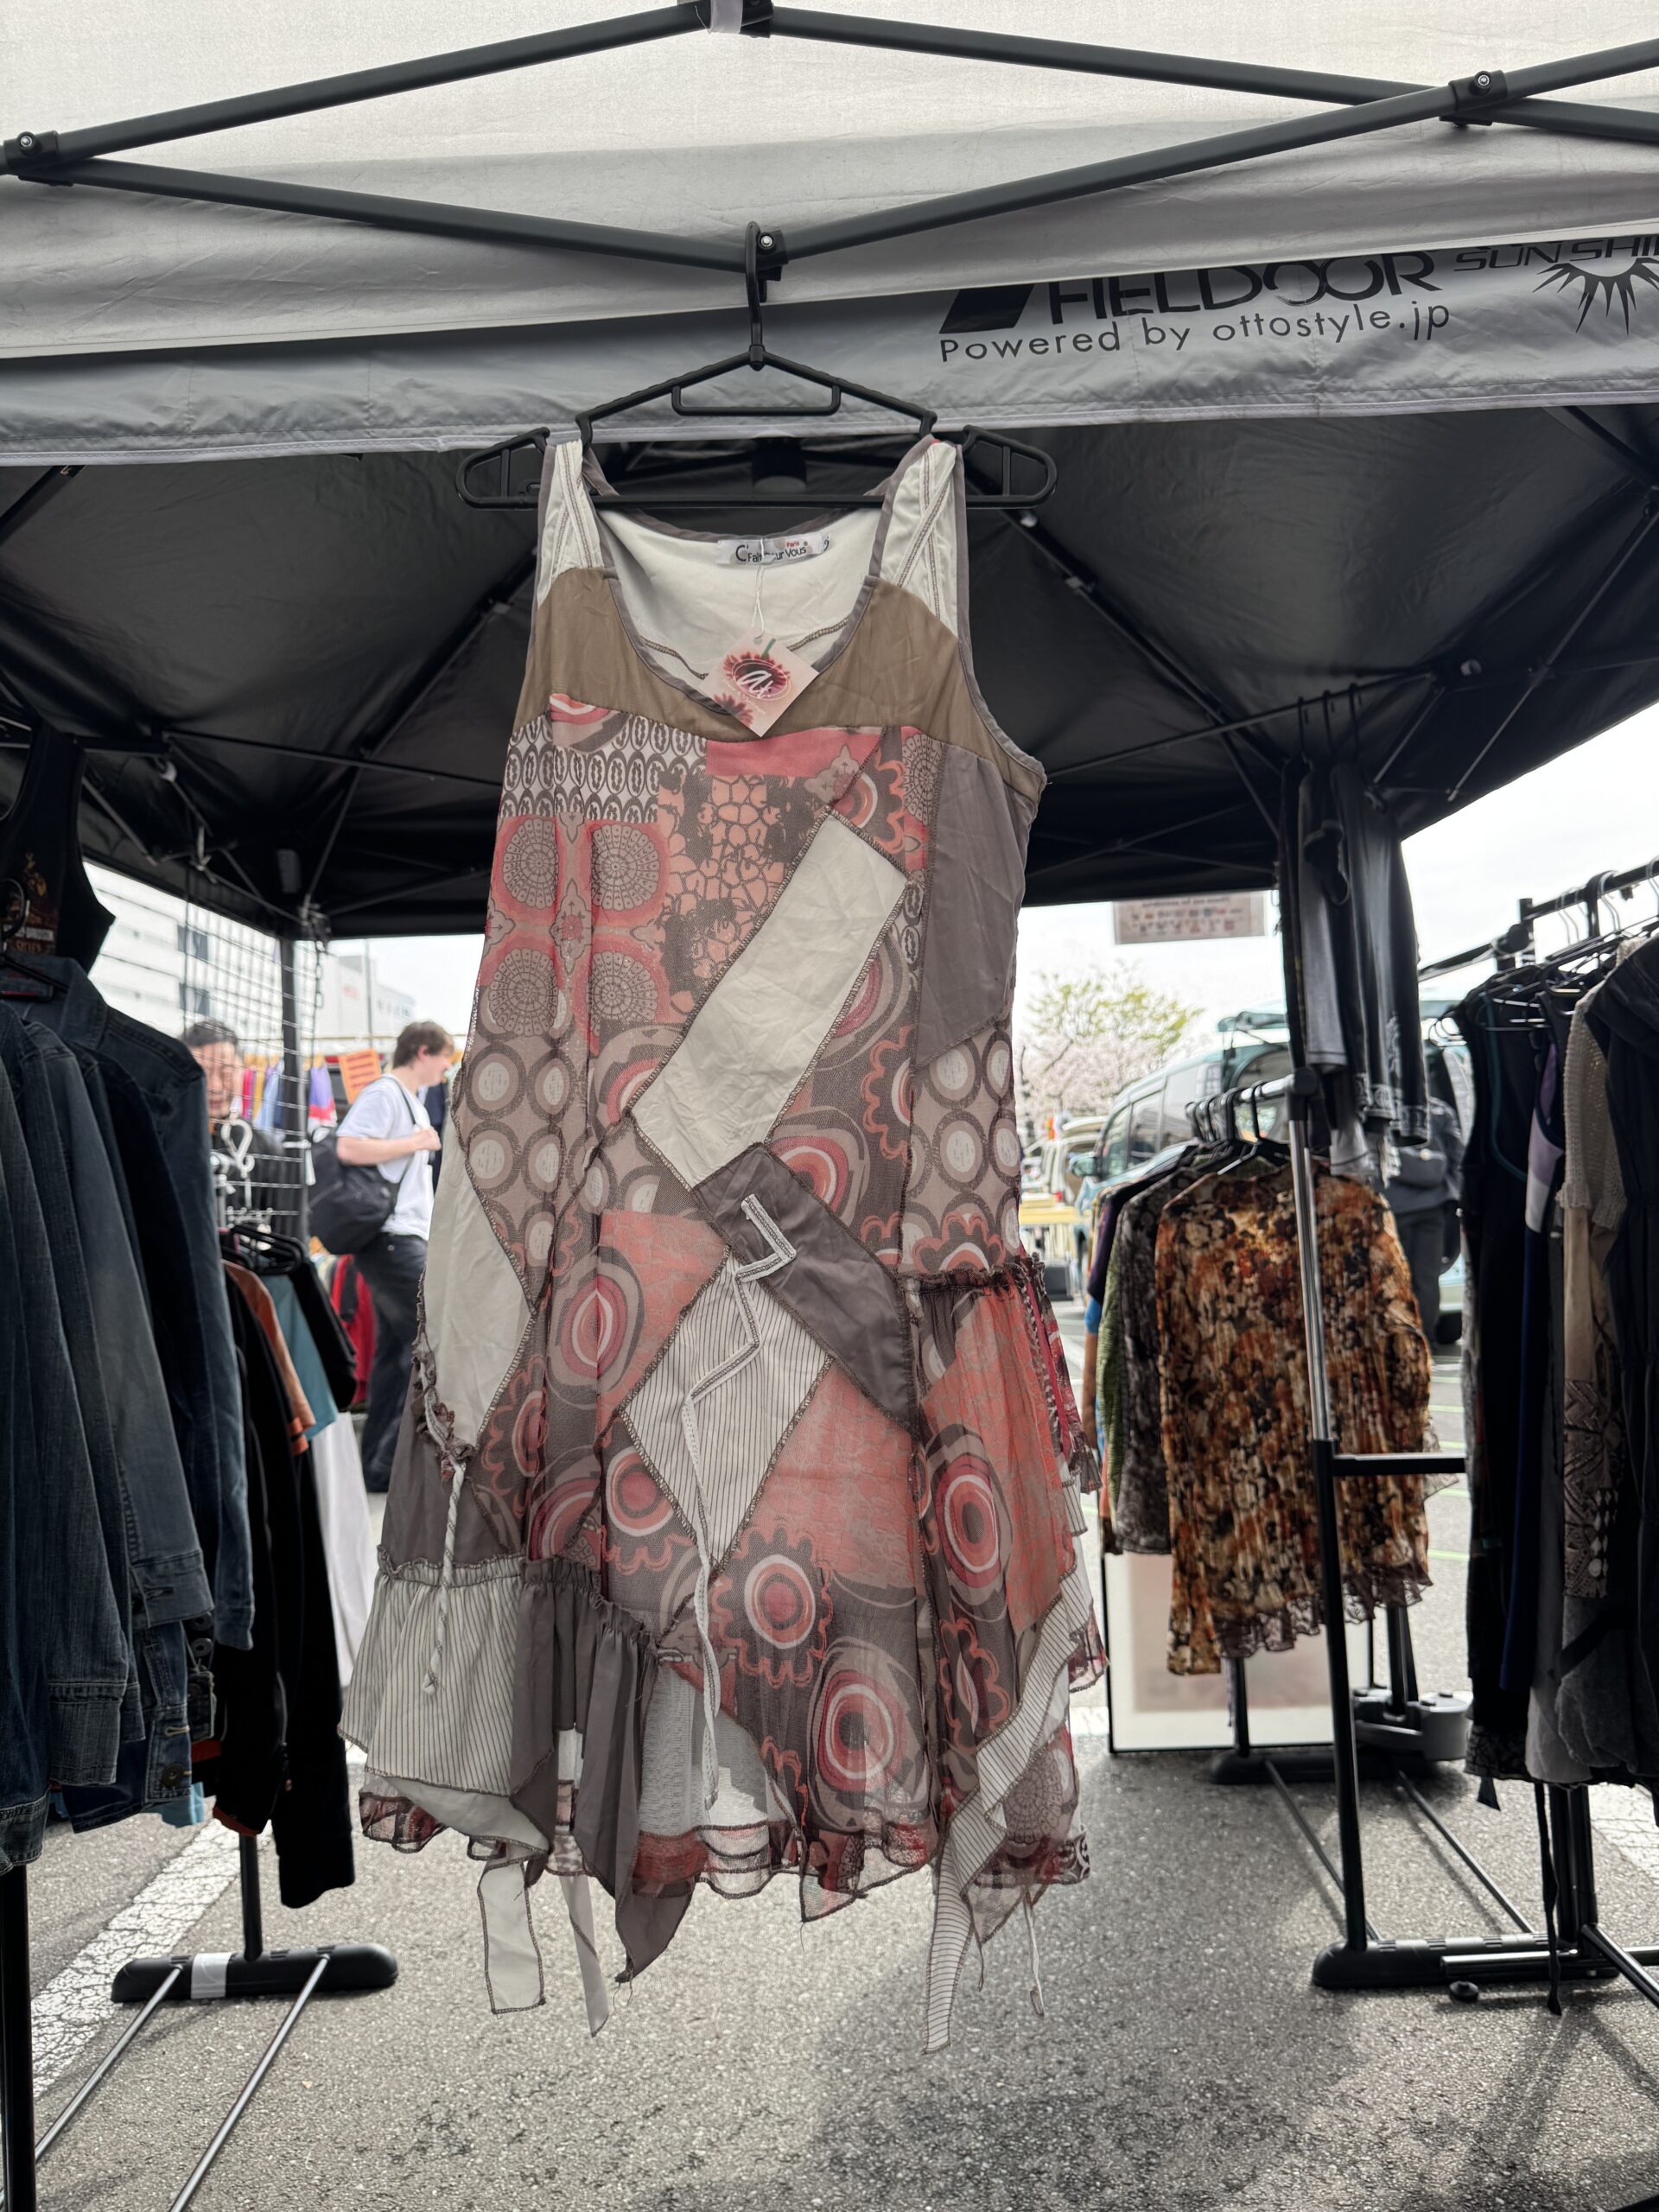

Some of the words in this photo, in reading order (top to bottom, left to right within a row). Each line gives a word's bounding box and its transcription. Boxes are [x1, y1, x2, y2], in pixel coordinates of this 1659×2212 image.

[939, 321, 1121, 363] Powered
[1141, 316, 1191, 351] by
[1212, 300, 1450, 344] ottostyle.jp
[785, 545, 807, 557] Vous
